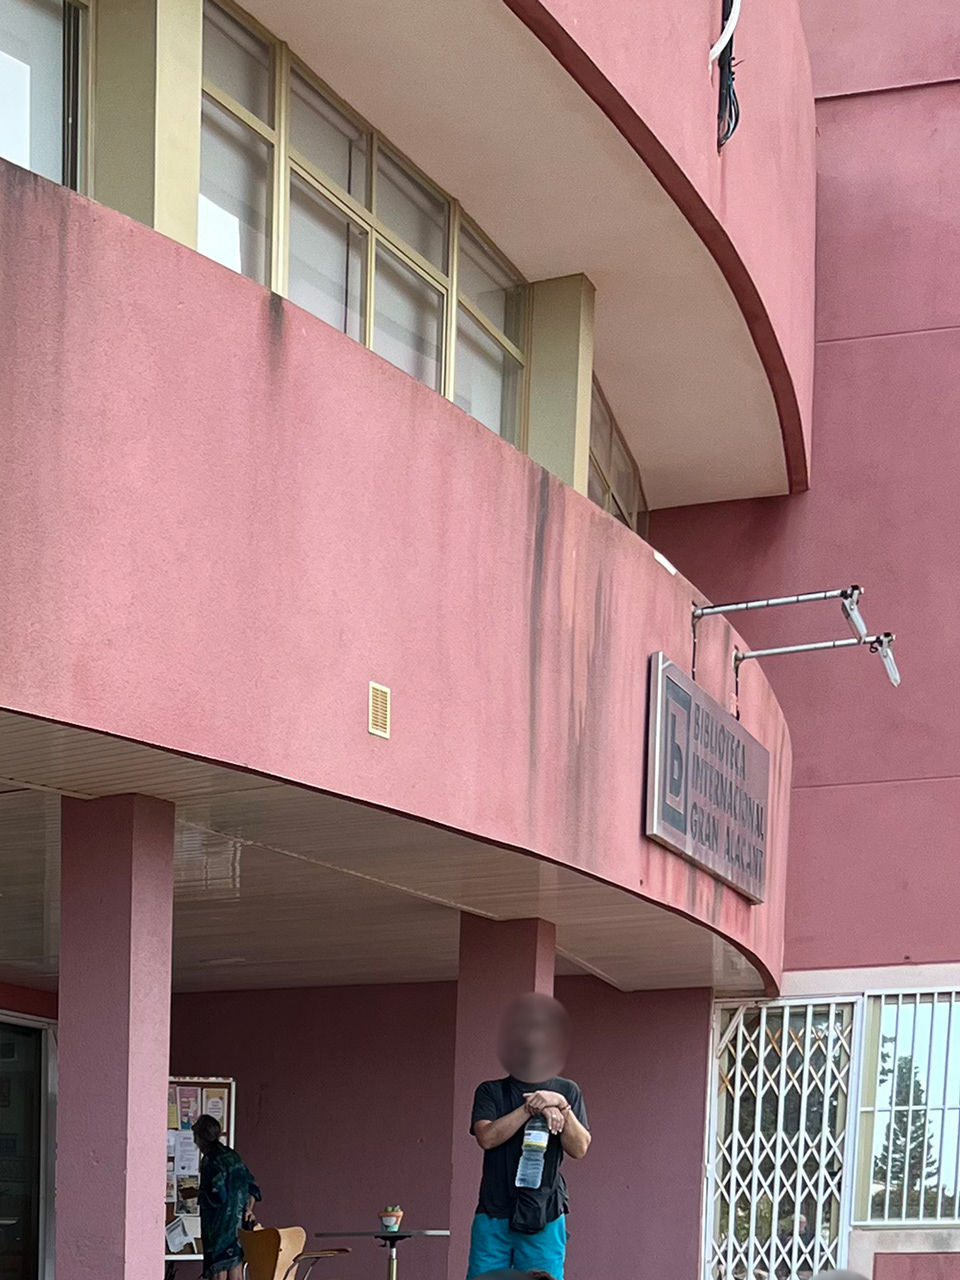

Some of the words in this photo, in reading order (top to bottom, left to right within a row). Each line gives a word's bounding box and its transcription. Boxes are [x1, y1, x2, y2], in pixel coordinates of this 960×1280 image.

[693, 702, 746, 781] BIBLIOTECA
[691, 751, 764, 842] INTERNACIONAL
[690, 801, 719, 854] GRAN
[724, 825, 764, 884] ALACANT
